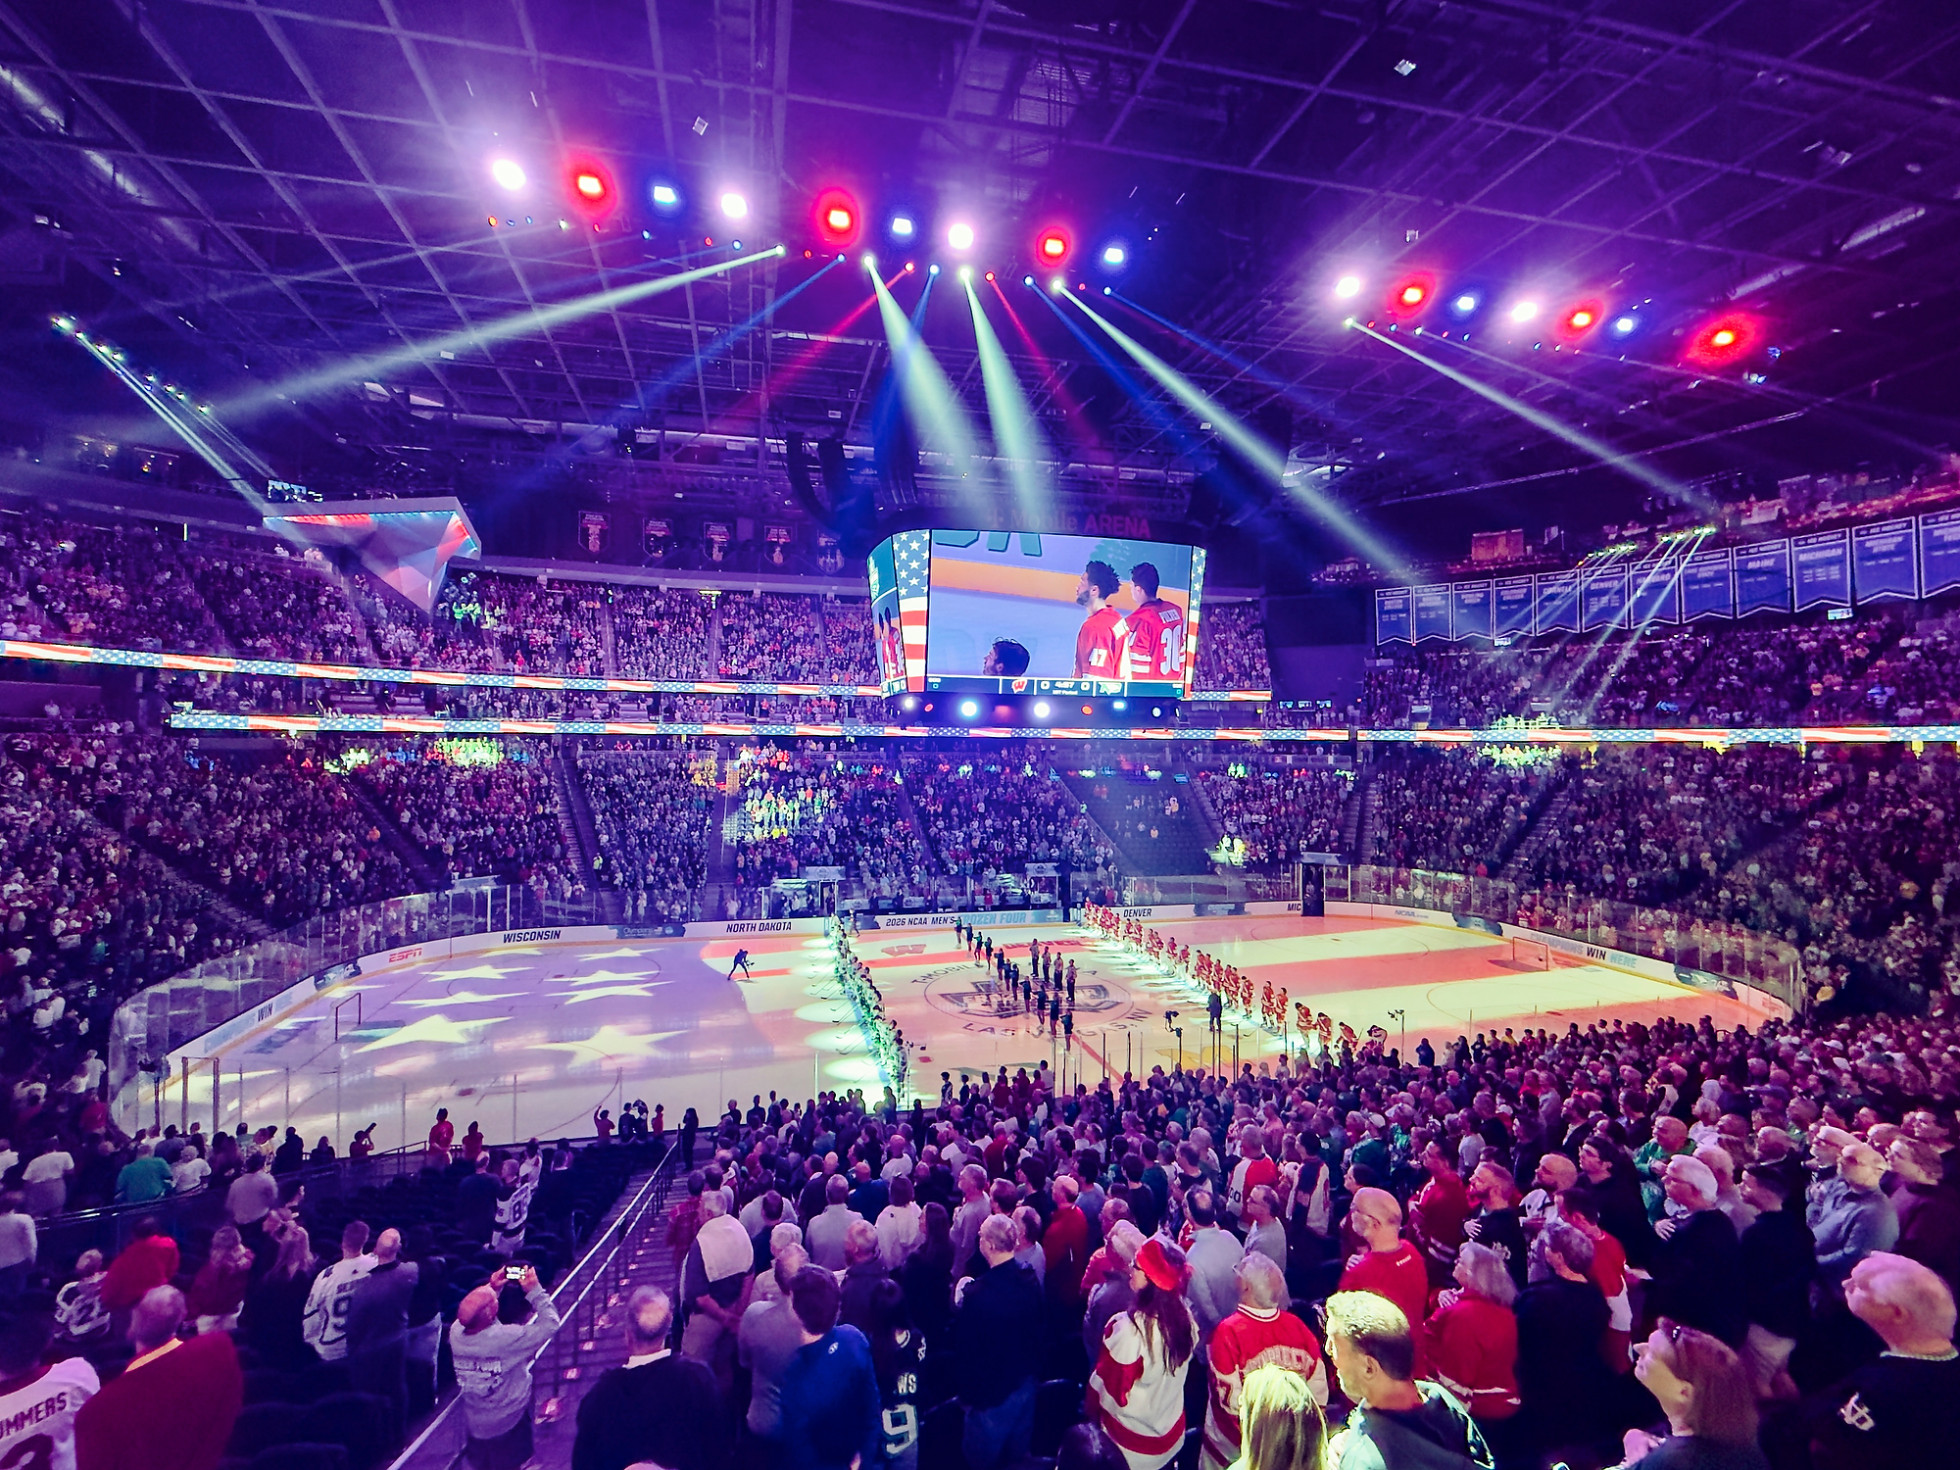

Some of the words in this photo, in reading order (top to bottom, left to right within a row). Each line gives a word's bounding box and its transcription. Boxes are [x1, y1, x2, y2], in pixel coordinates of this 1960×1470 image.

[1083, 514, 1152, 540] ARENA
[1159, 625, 1182, 676] 30
[885, 917, 906, 927] 2026
[907, 916, 927, 926] NCAA
[930, 915, 955, 925] MEN'S
[999, 912, 1027, 924] FOUR
[1123, 908, 1152, 918] DENVER
[726, 922, 756, 933] NORTH
[758, 920, 792, 932] DAKOTA
[503, 929, 561, 943] WISCONSIN
[388, 947, 423, 963] ESPN
[1586, 945, 1607, 961] WIN
[911, 963, 978, 984] T-MOBIL
[257, 1002, 274, 1022] WIN
